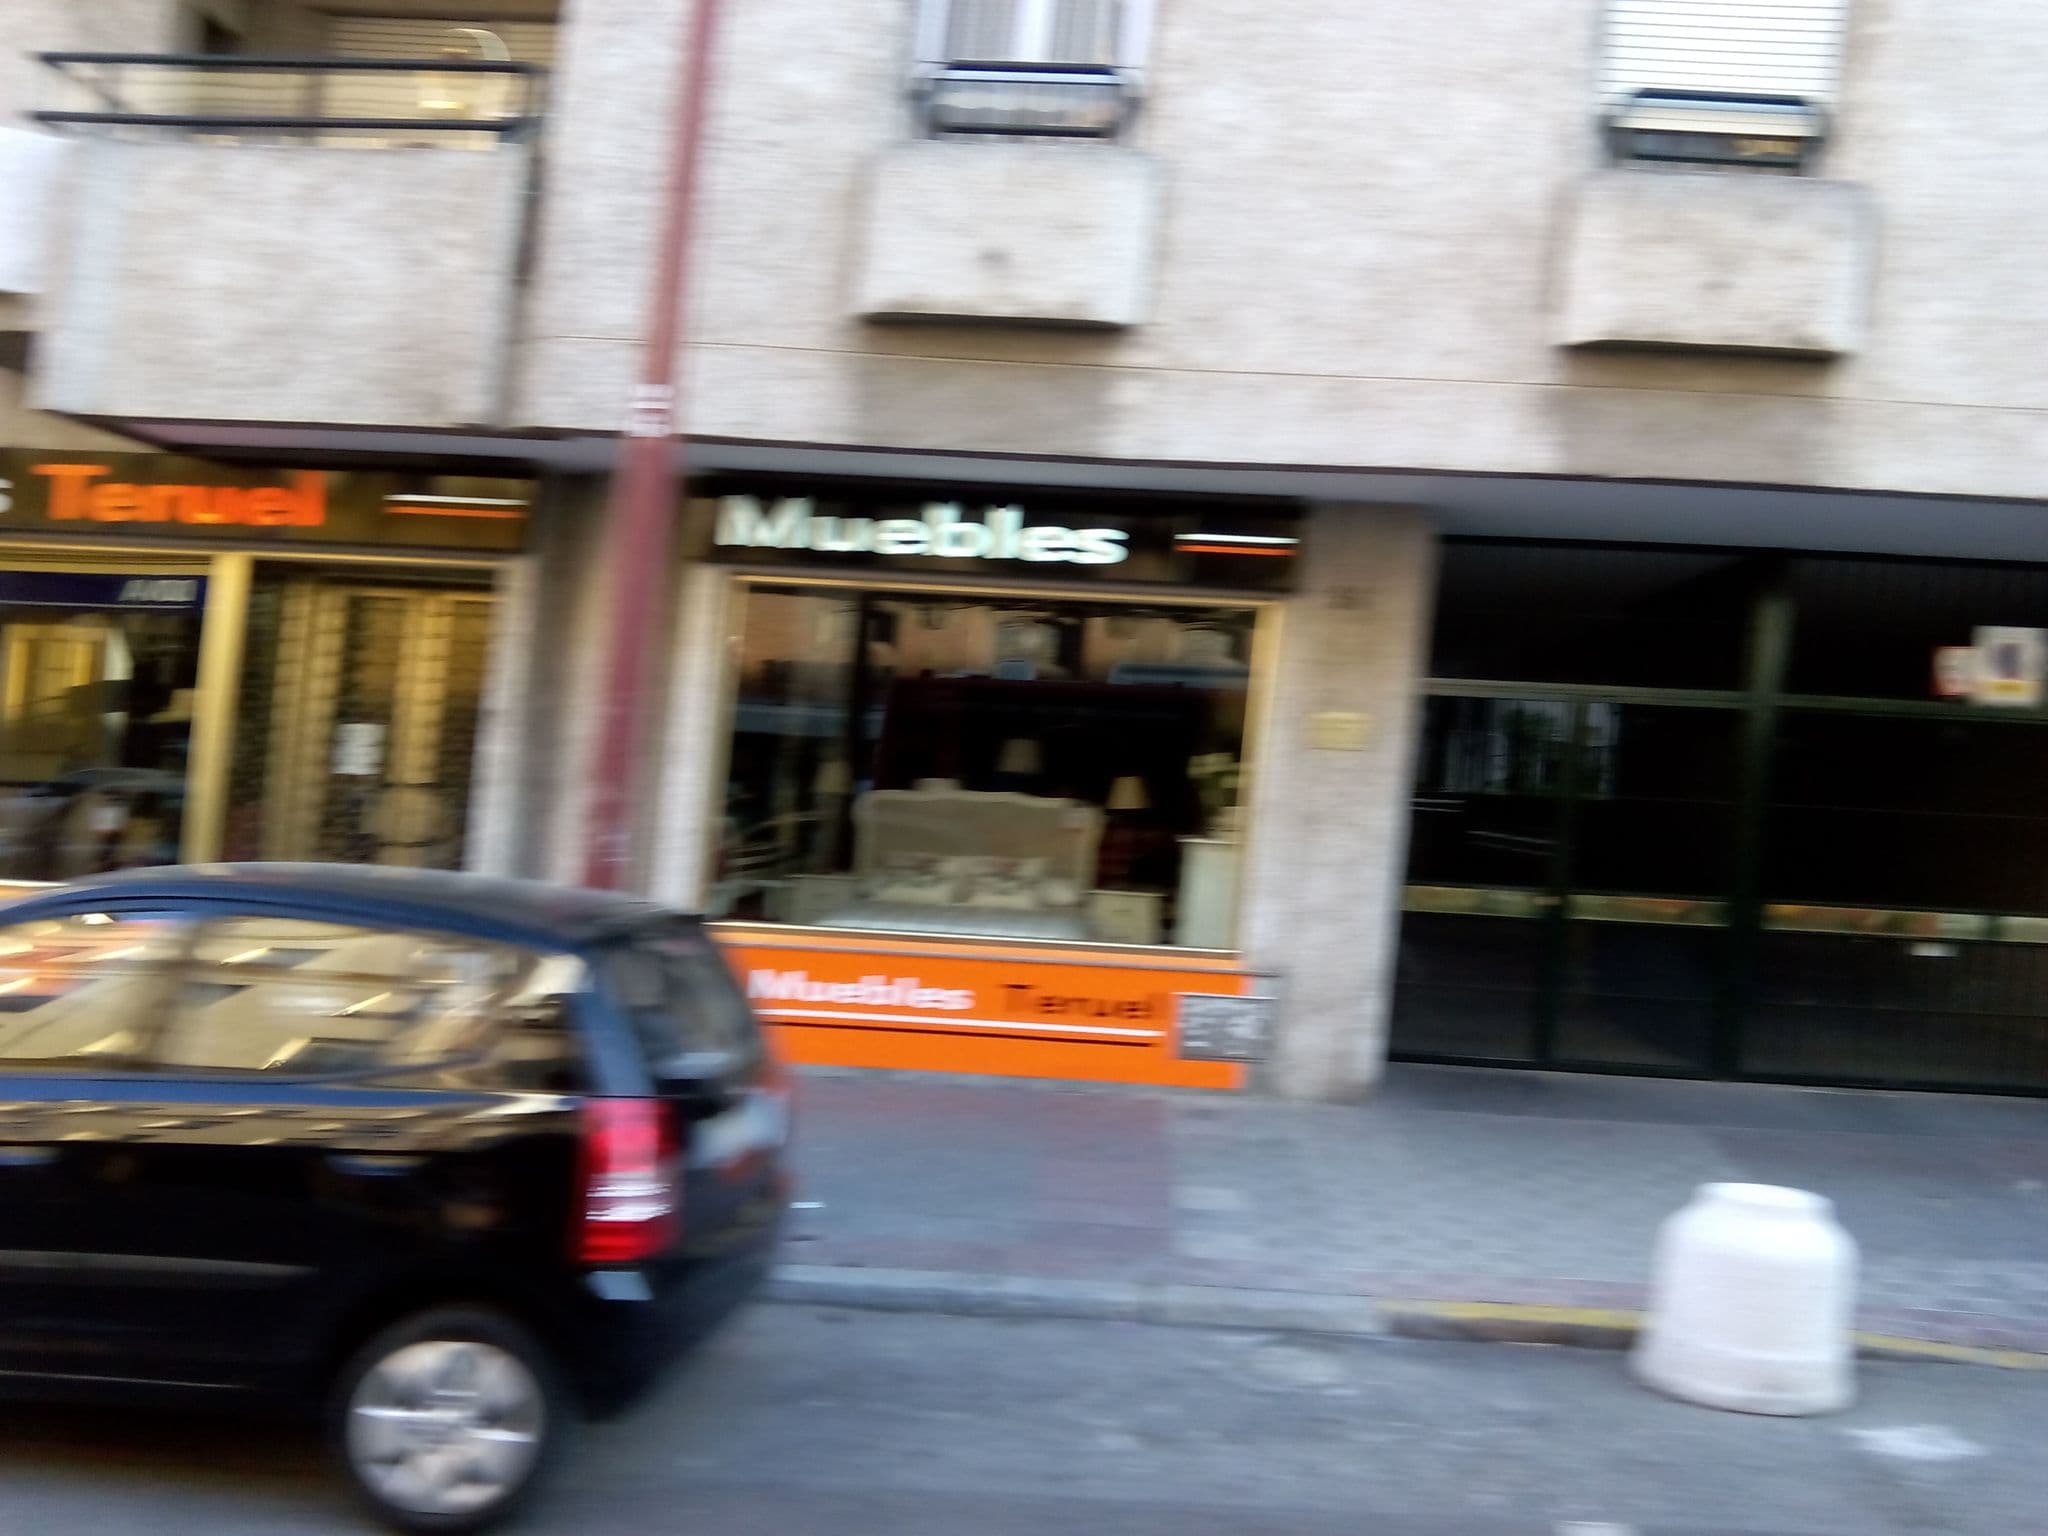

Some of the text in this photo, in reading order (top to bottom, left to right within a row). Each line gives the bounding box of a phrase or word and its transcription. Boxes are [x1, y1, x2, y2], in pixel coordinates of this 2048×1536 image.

[33, 463, 327, 526] Teruel
[714, 495, 1130, 564] Muebles
[748, 969, 1167, 1020] Muebles Teruel
